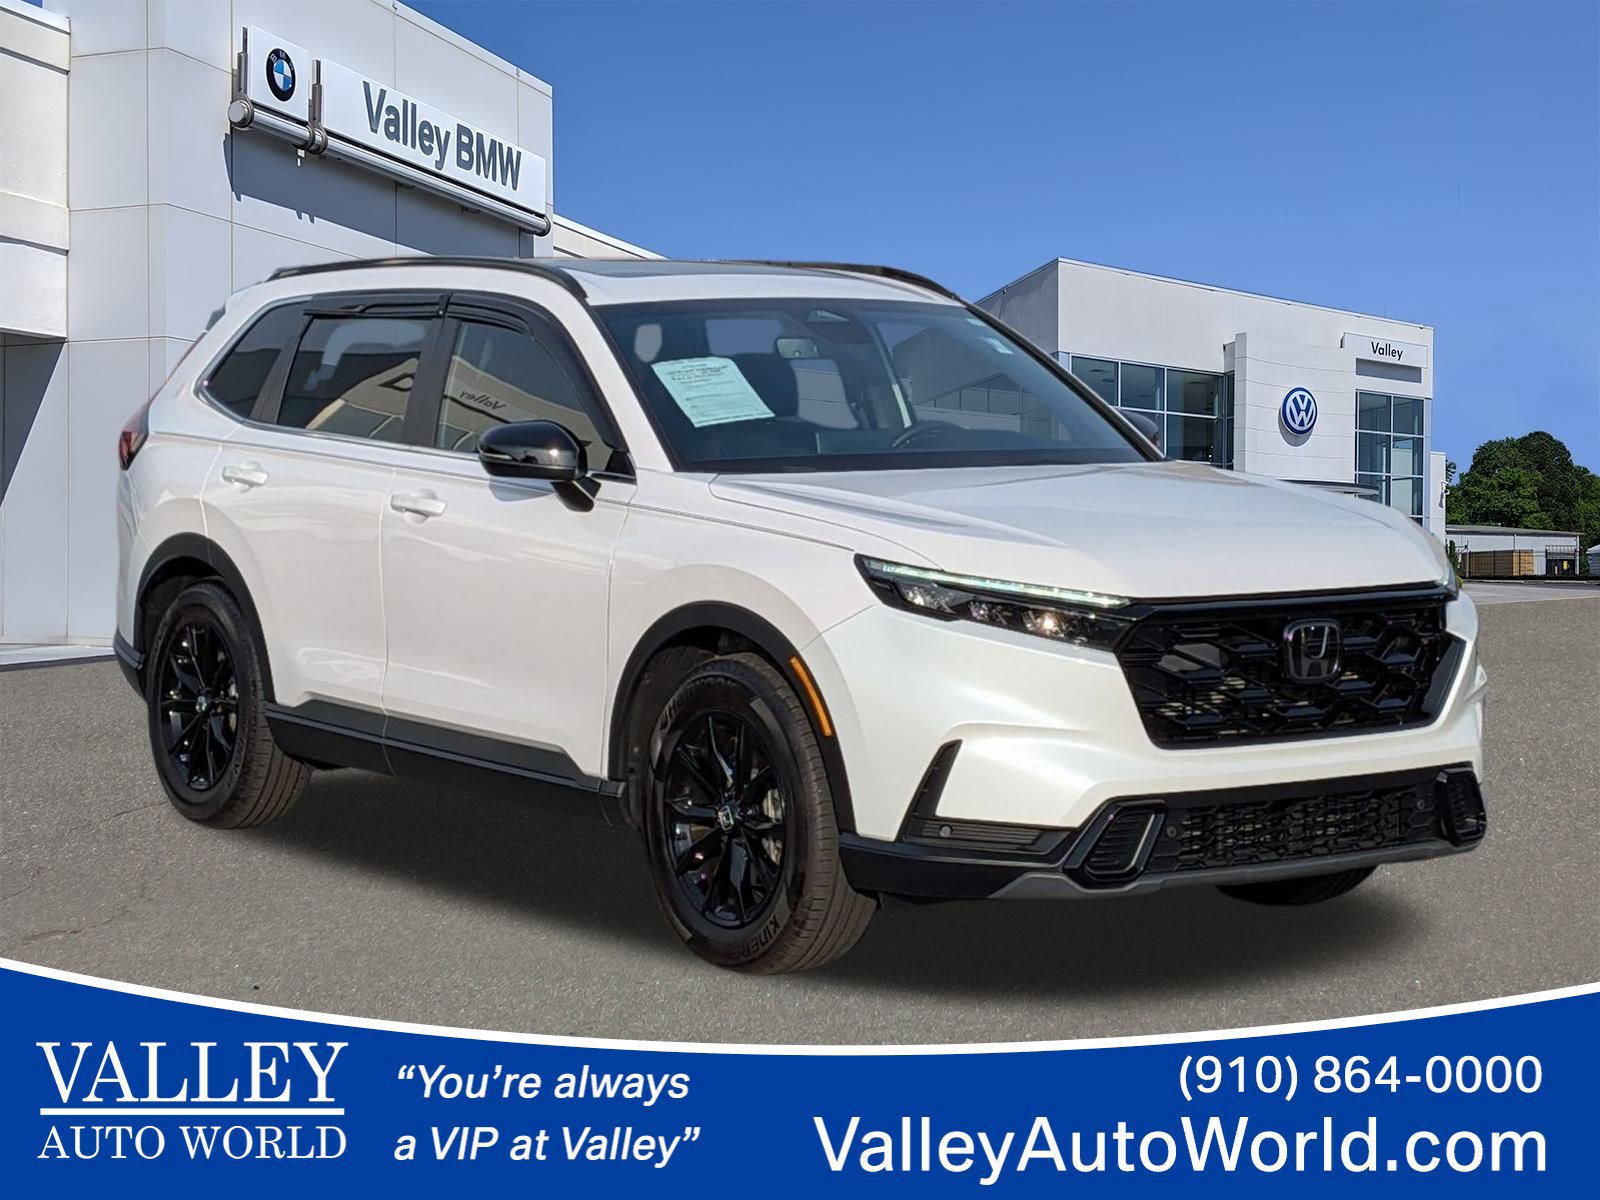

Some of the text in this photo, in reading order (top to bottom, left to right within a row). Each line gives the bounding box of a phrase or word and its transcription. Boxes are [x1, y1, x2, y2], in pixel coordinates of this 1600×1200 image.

[362, 80, 522, 191] Valley BMW
[1371, 341, 1403, 361] Valley
[731, 912, 782, 959] KINER
